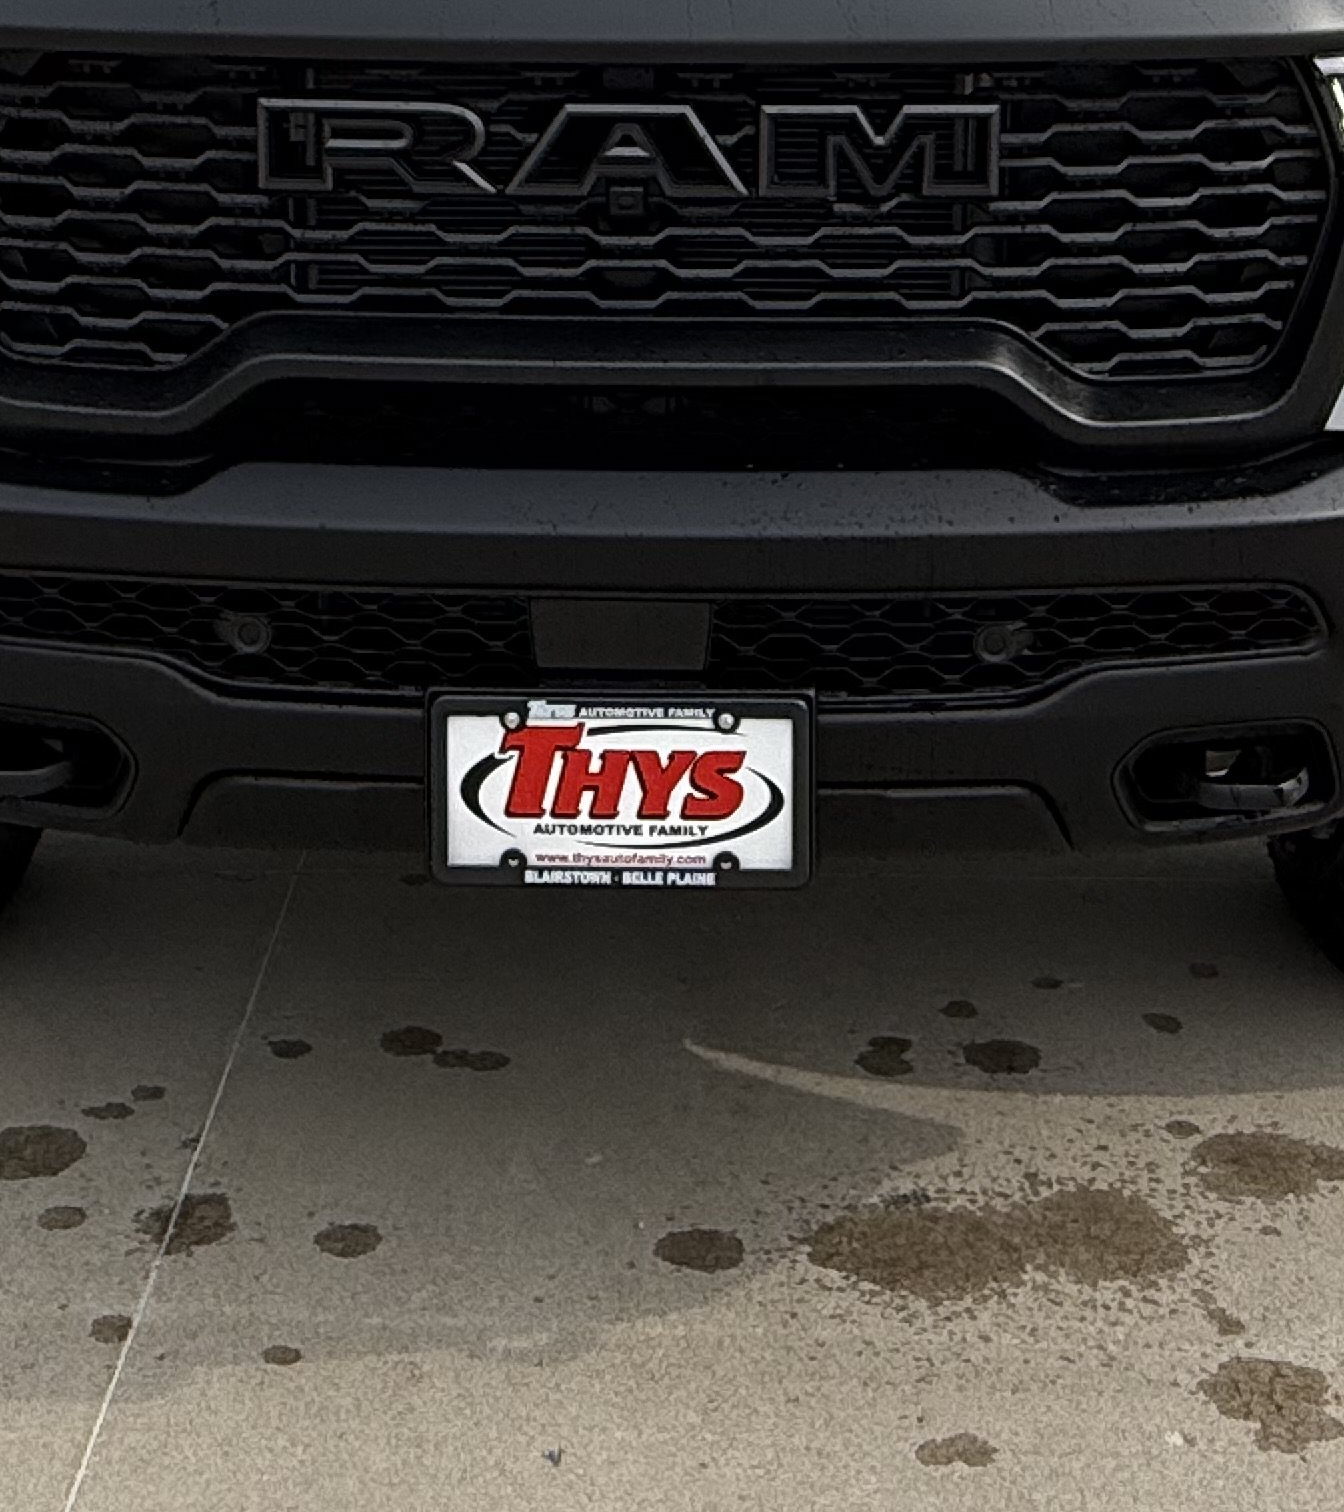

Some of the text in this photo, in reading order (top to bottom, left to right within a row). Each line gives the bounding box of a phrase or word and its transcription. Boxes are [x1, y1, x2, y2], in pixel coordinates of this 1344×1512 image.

[257, 97, 1001, 197] RAM
[578, 706, 665, 719] AUTOMOTIVE
[668, 707, 716, 719] FAMILY
[499, 722, 747, 820] THYS
[533, 823, 709, 837] AUTOMOTIVE FAMILY
[534, 852, 707, 867] www.thysautofamily.com
[523, 869, 717, 887] BLAIRSTOWN BELLE PLAINE
